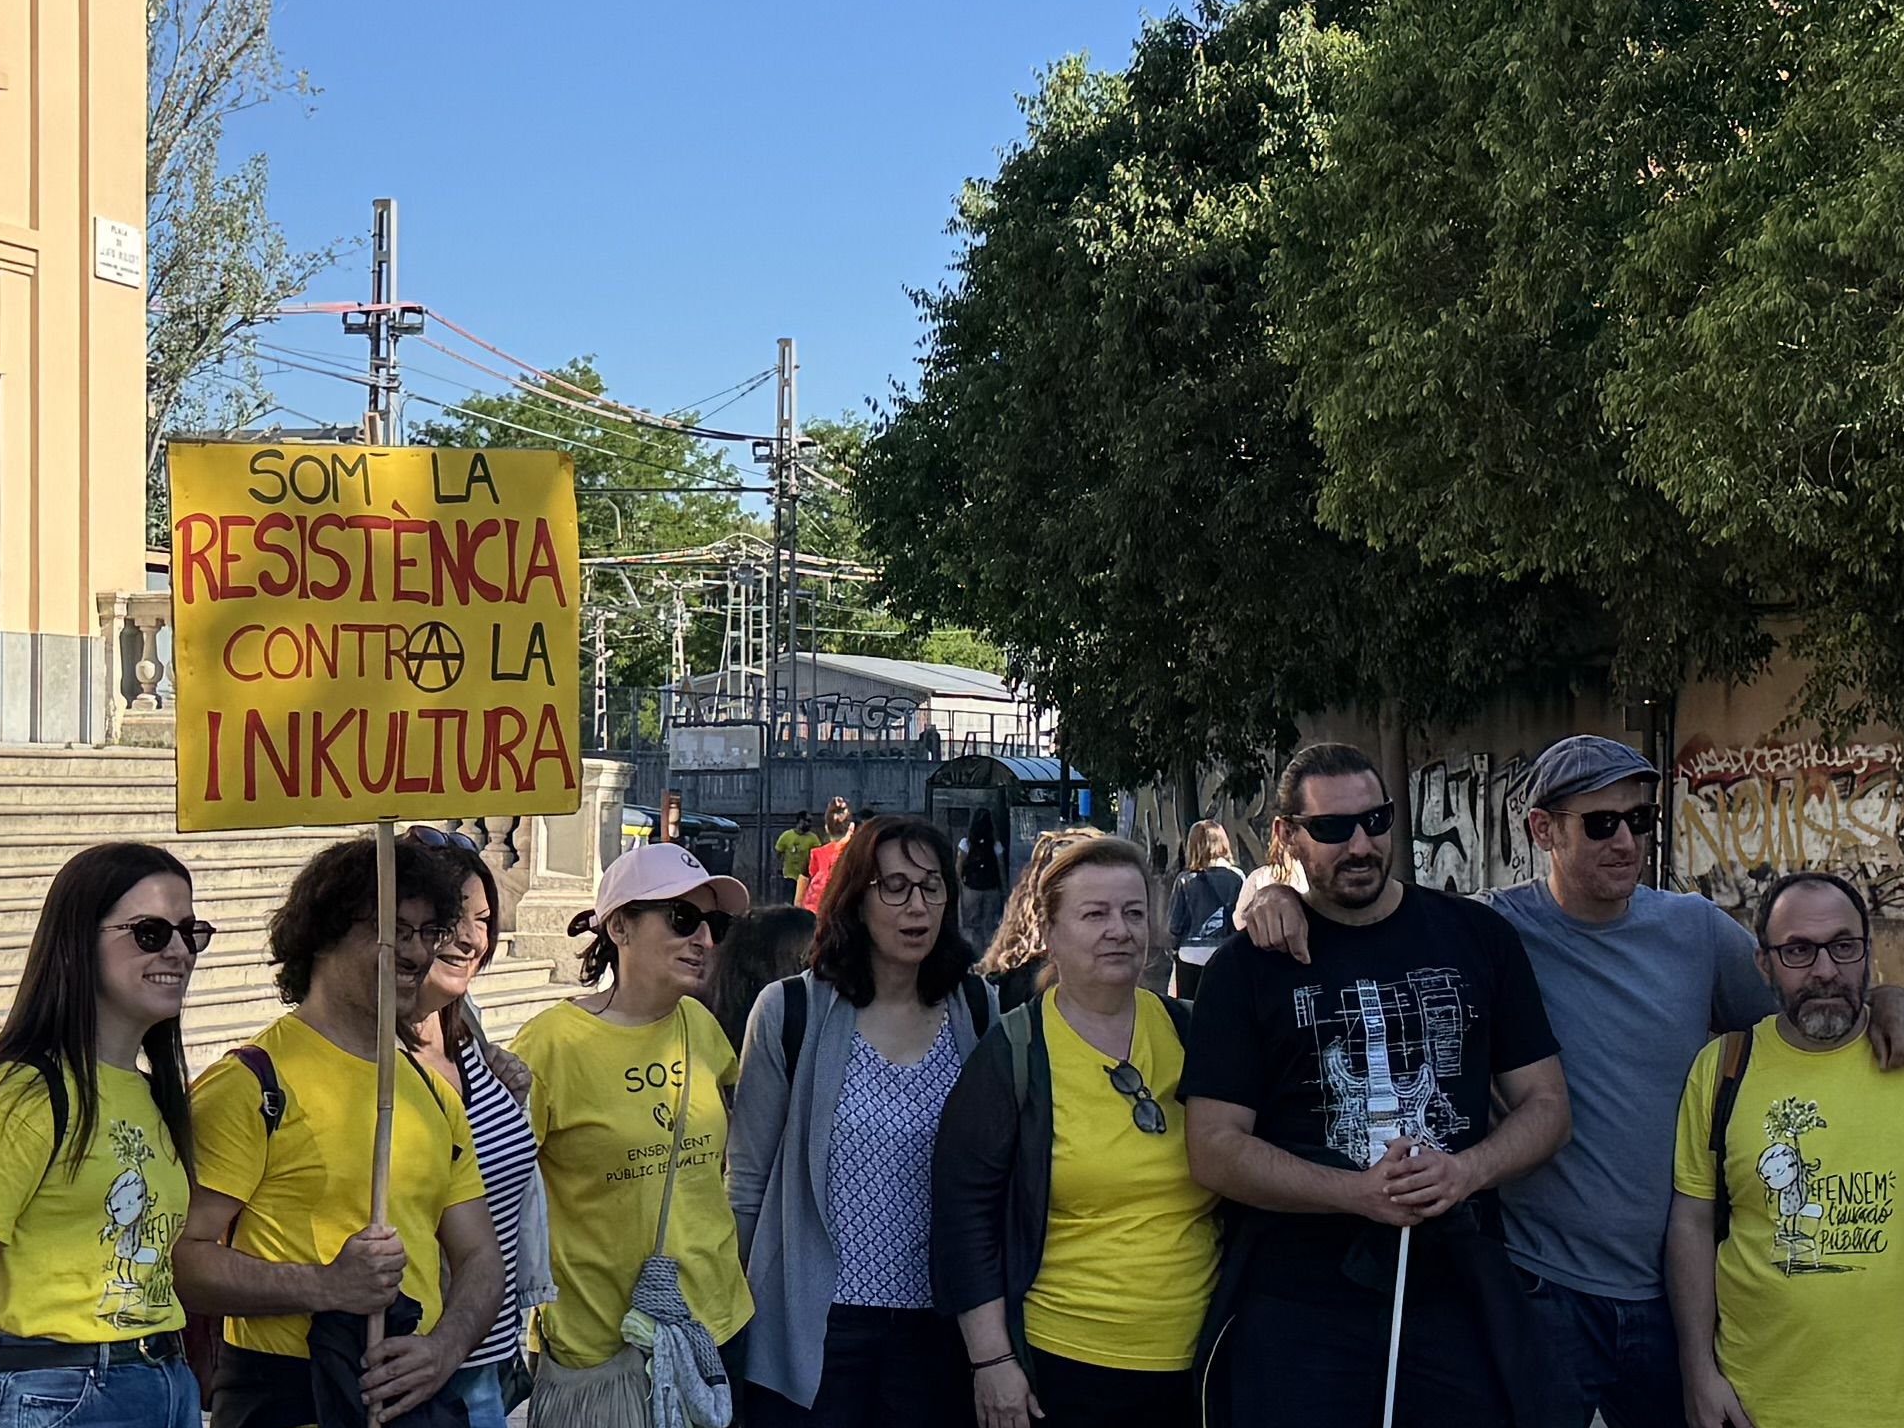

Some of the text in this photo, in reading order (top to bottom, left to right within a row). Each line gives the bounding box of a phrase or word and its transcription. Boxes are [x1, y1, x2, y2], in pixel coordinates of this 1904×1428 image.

[248, 449, 500, 506] SOM LA
[174, 499, 568, 608] RESISTÈNCIA
[222, 620, 556, 694] CONTRA LA
[203, 703, 578, 802] INKULTURA
[624, 1060, 683, 1093] SOS
[1807, 1171, 1887, 1206] EFENSEM
